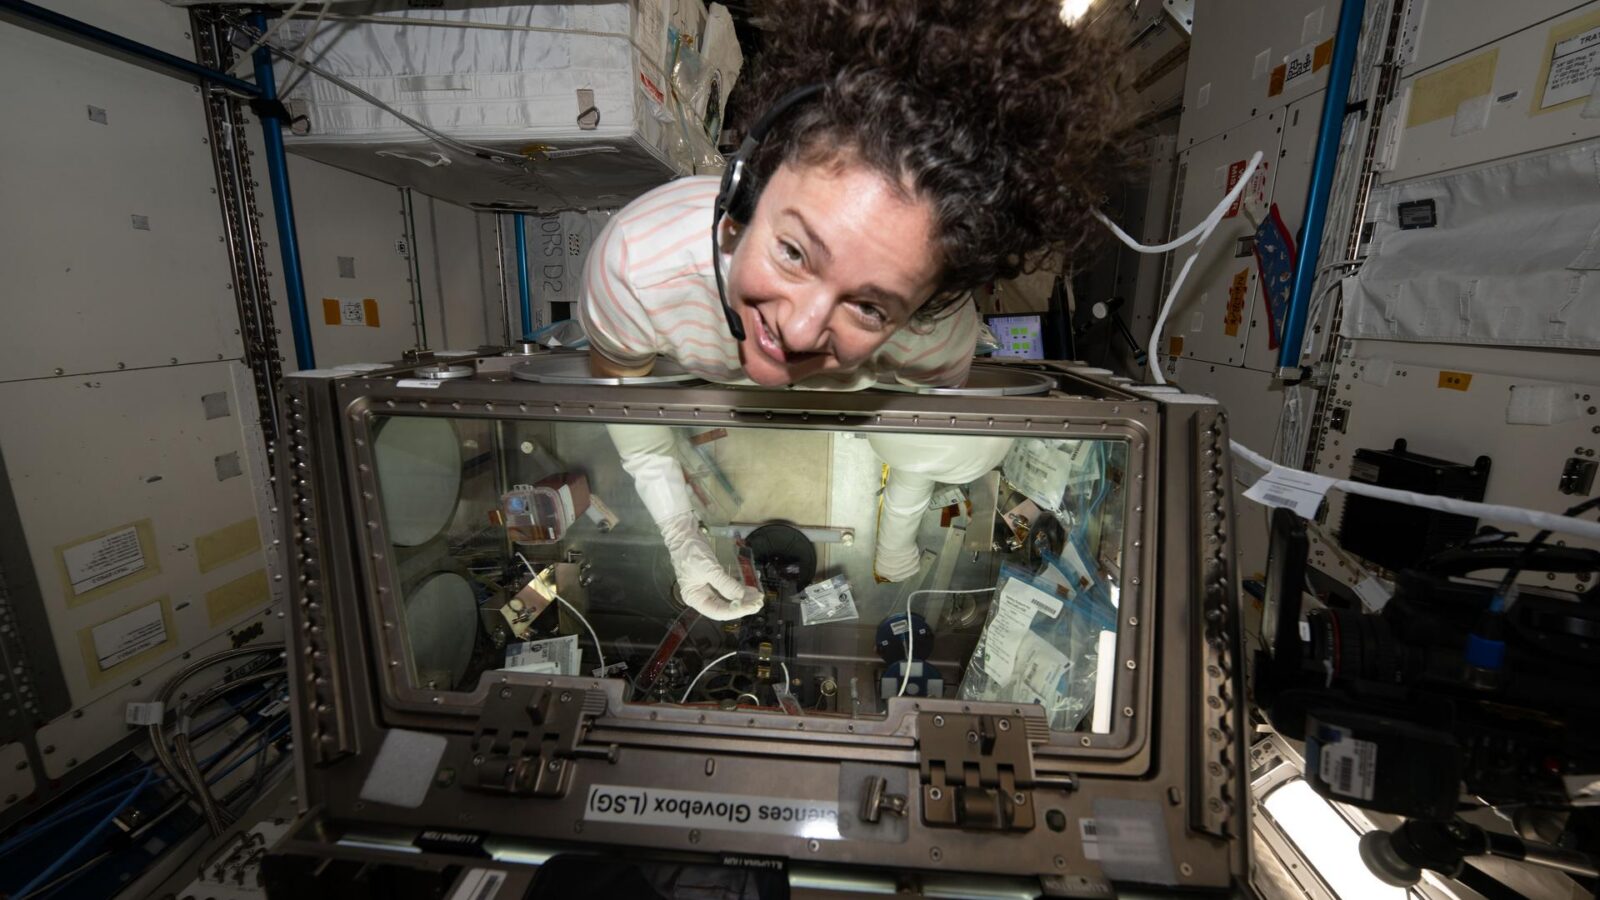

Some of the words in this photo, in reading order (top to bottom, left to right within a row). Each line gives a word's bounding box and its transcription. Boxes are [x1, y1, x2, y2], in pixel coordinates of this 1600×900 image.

[543, 264, 563, 292] D2
[590, 788, 648, 822] (LSG)
[654, 797, 751, 823] Glovebox
